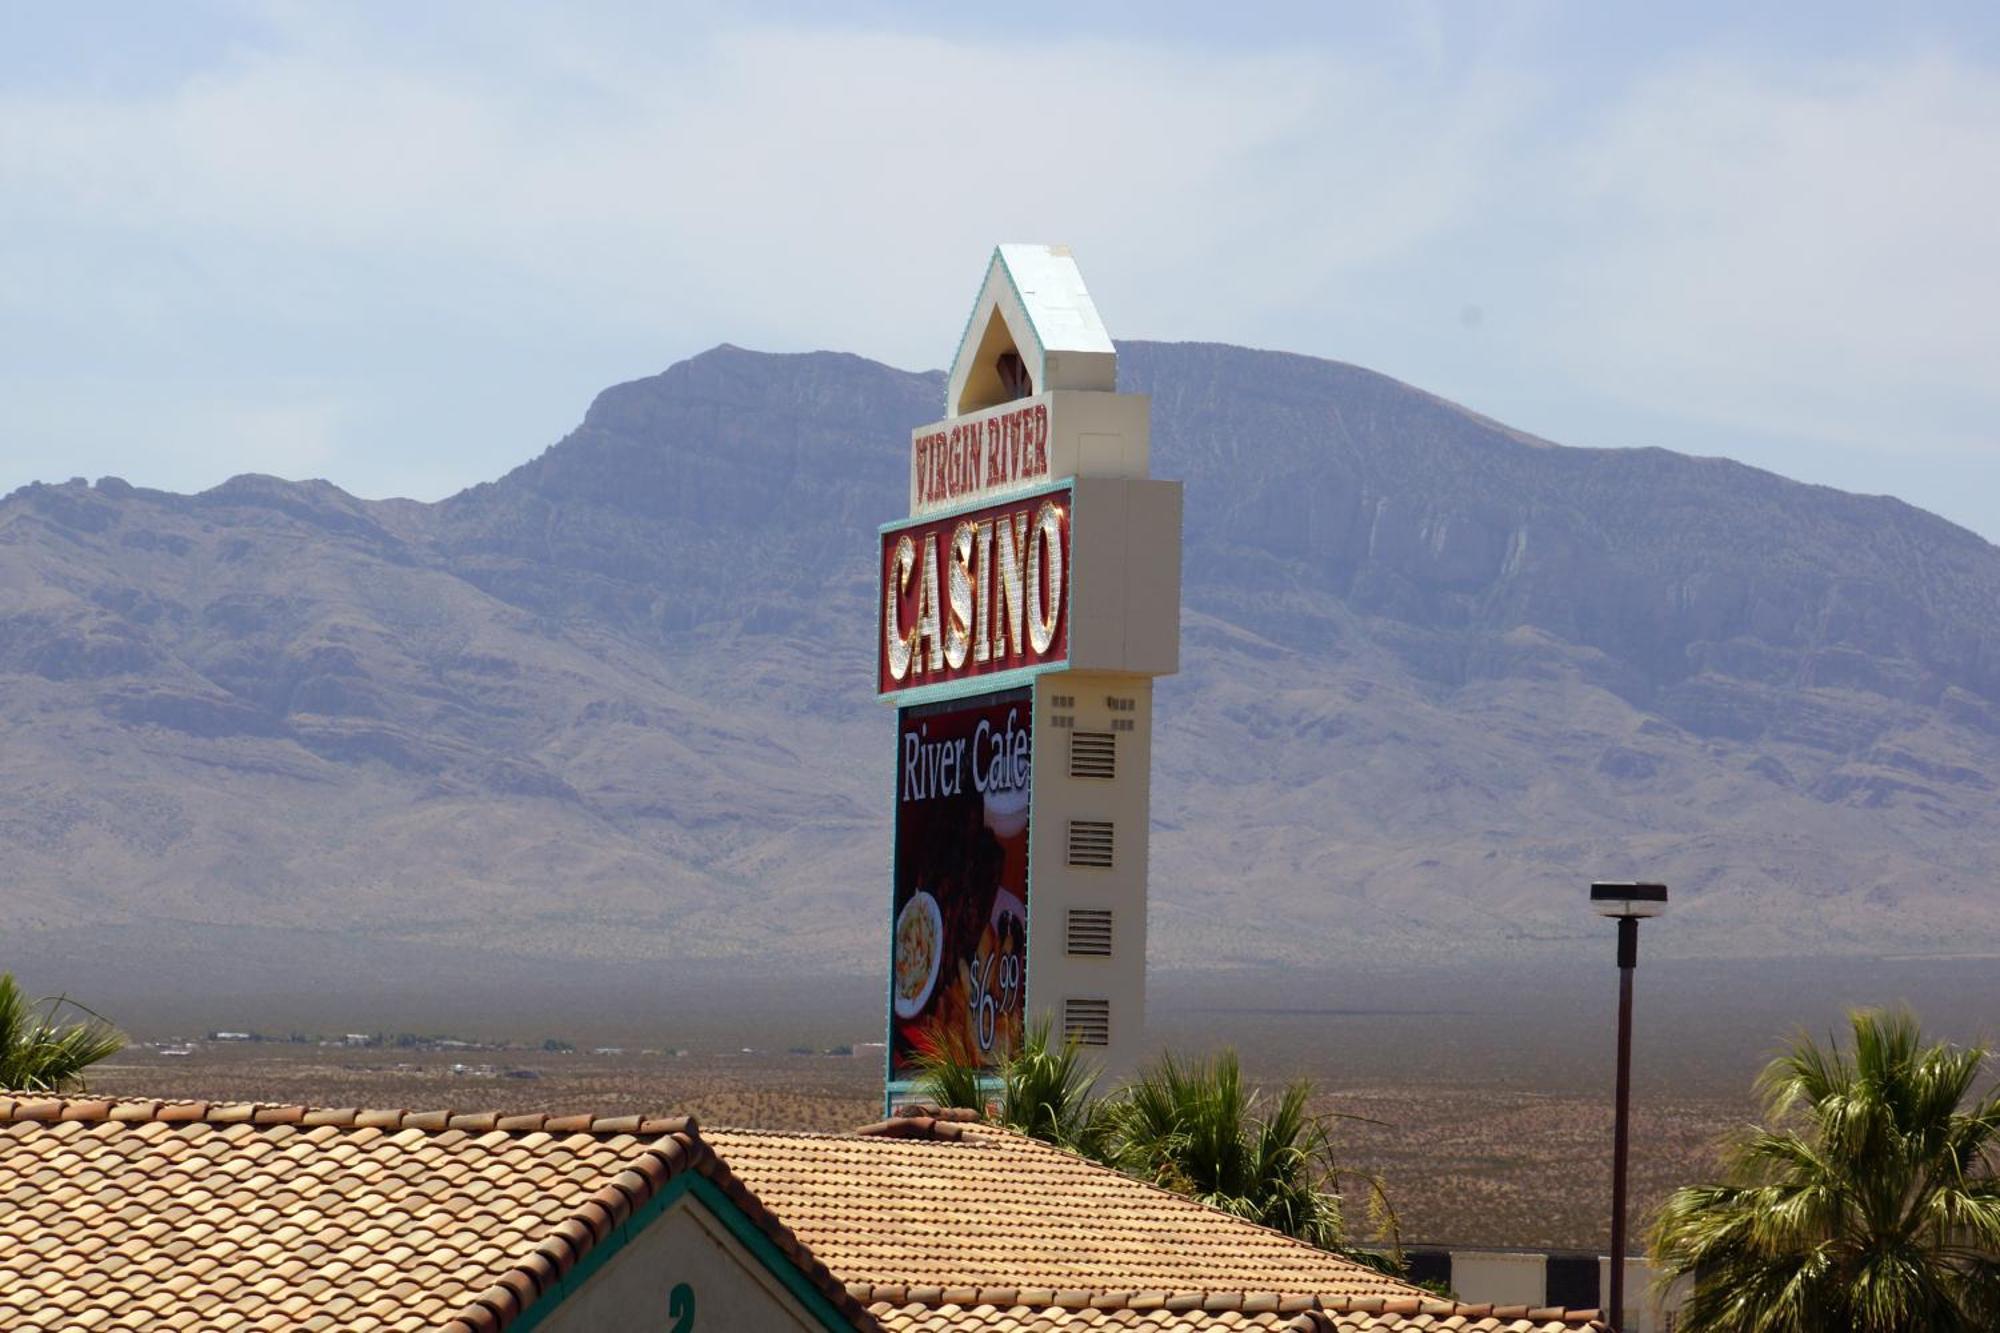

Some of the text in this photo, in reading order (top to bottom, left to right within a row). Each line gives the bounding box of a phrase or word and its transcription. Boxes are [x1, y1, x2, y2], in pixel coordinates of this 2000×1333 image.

[915, 403, 1048, 504] VIRGIN RIVER
[887, 501, 1062, 680] CASINO
[904, 708, 1029, 801] River Cafe
[670, 1282, 695, 1333] 2
